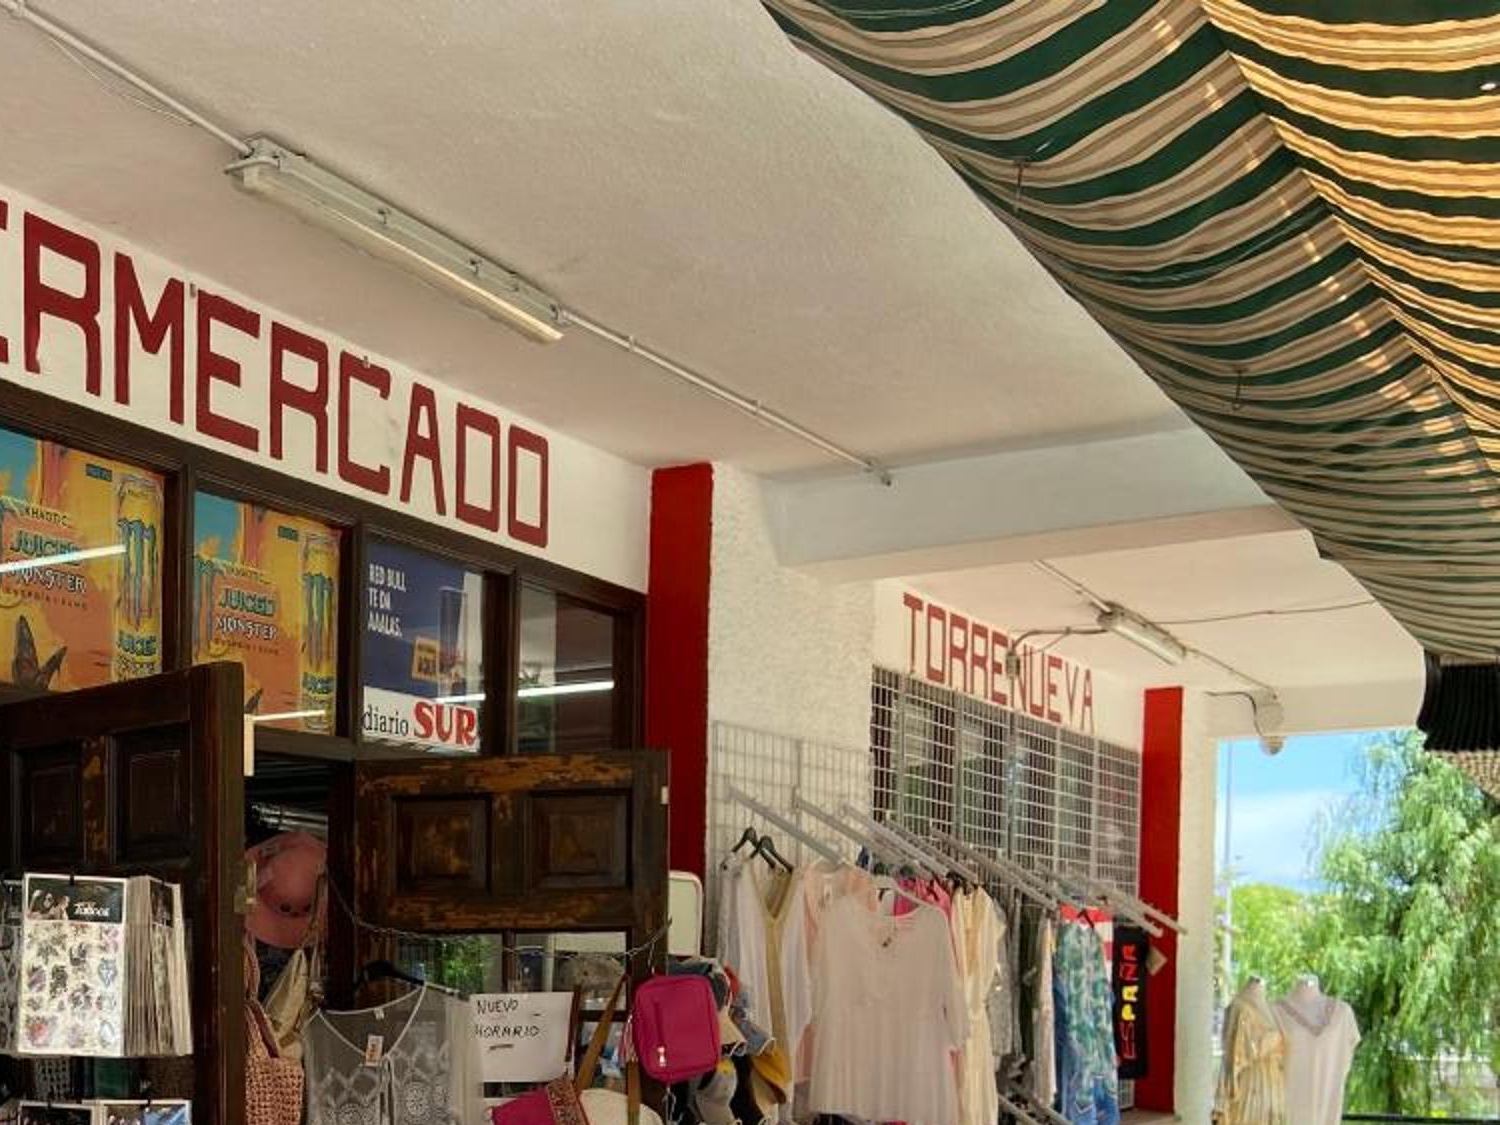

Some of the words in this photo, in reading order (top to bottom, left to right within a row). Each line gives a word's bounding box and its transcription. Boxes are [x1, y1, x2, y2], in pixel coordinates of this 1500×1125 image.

[903, 591, 1095, 734] TORRENUEVA
[363, 704, 409, 736] diario
[413, 701, 477, 746] SUR
[477, 999, 519, 1015] NUEVO
[475, 1025, 541, 1039] HORARIO
